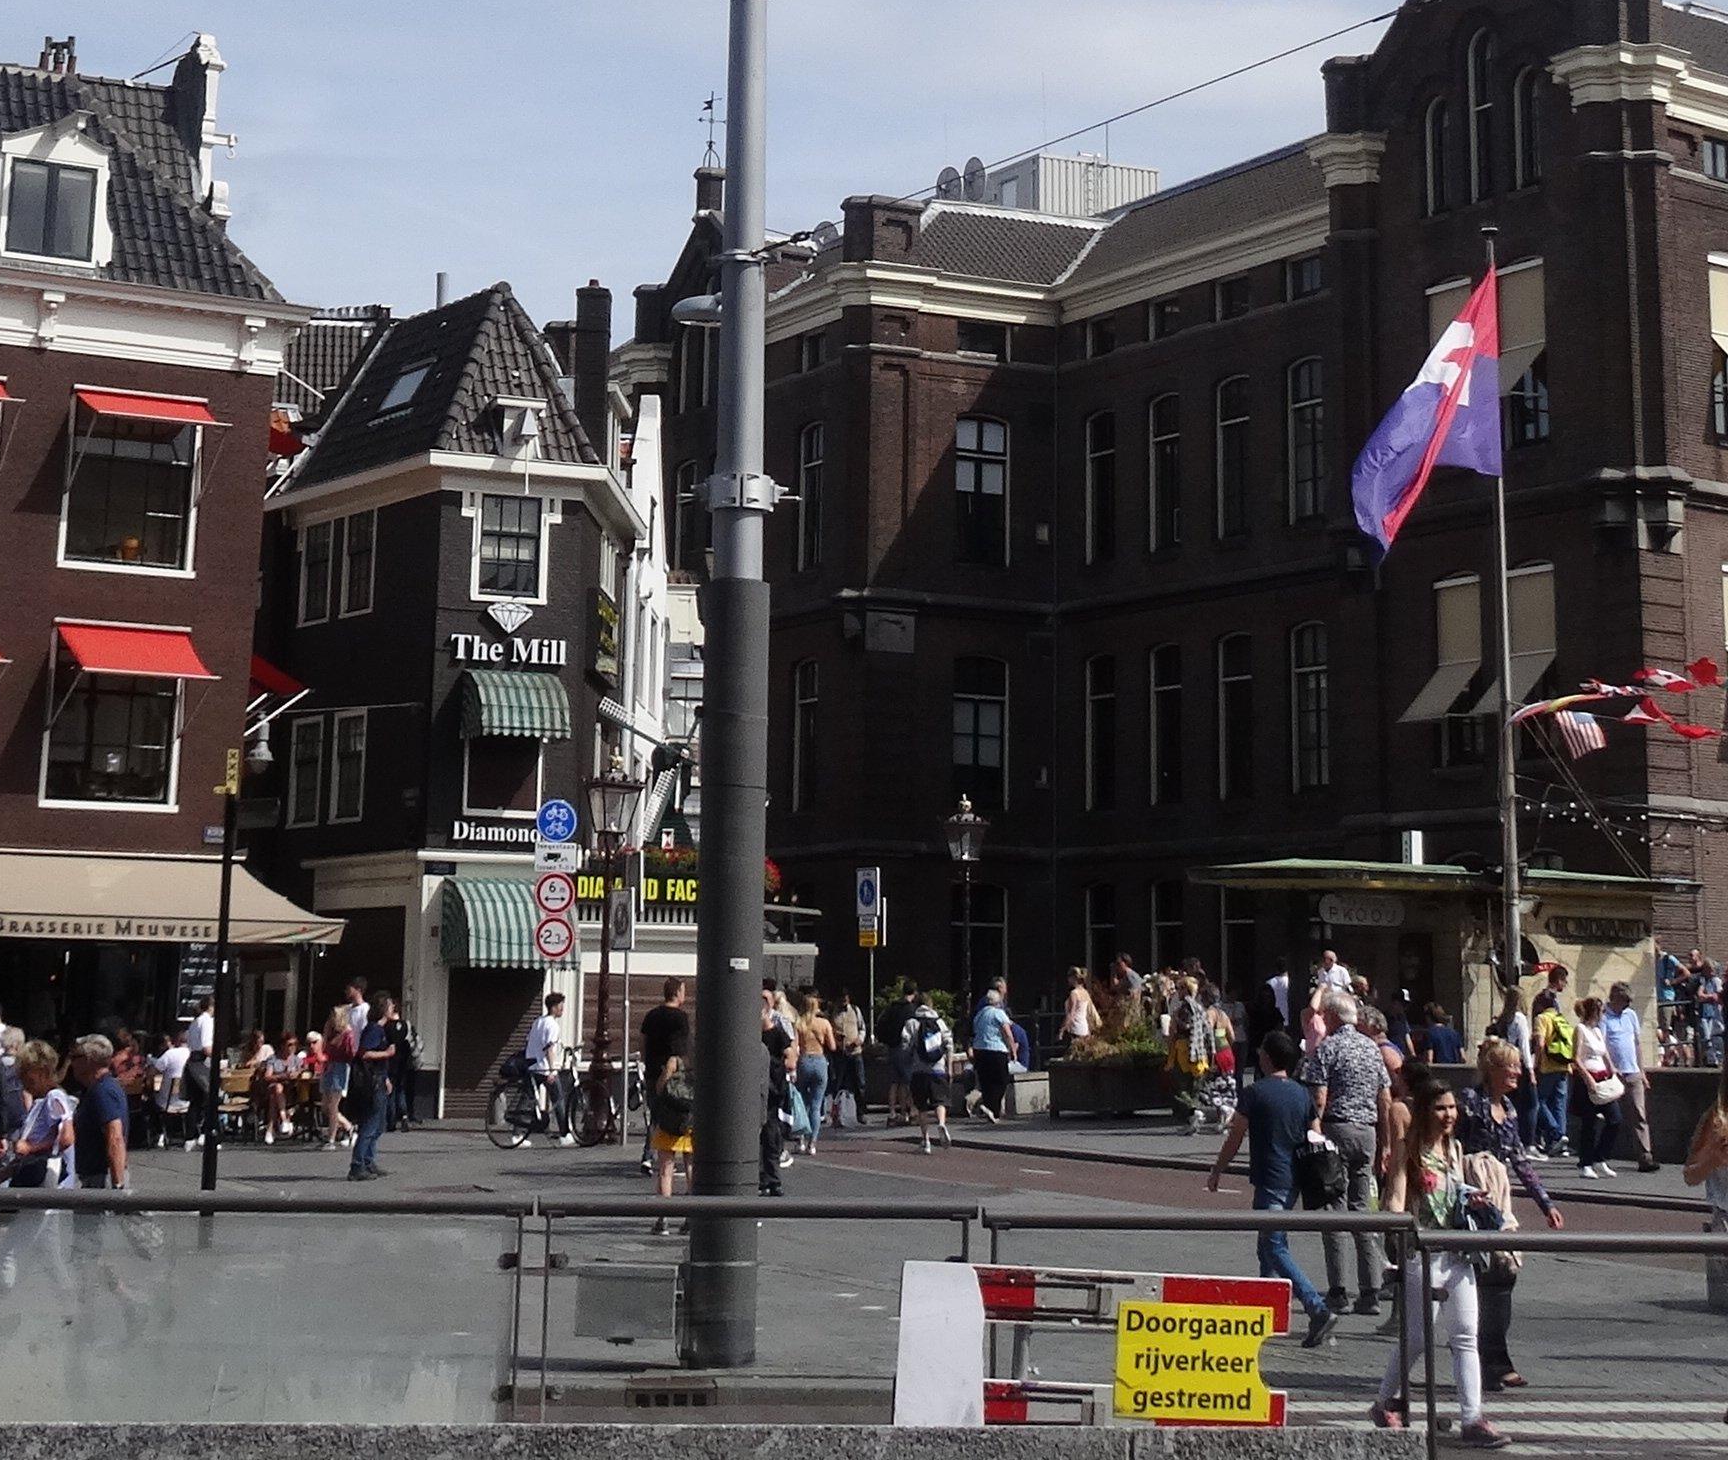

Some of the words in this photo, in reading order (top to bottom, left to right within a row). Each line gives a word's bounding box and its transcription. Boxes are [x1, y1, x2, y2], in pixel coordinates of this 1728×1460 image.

[450, 633, 504, 662] The
[510, 637, 567, 666] Mill
[548, 881, 557, 893] 6
[1125, 1309, 1265, 1340] Doorgaand
[1134, 1347, 1255, 1376] rijverkeer
[1132, 1388, 1251, 1413] gestremd
